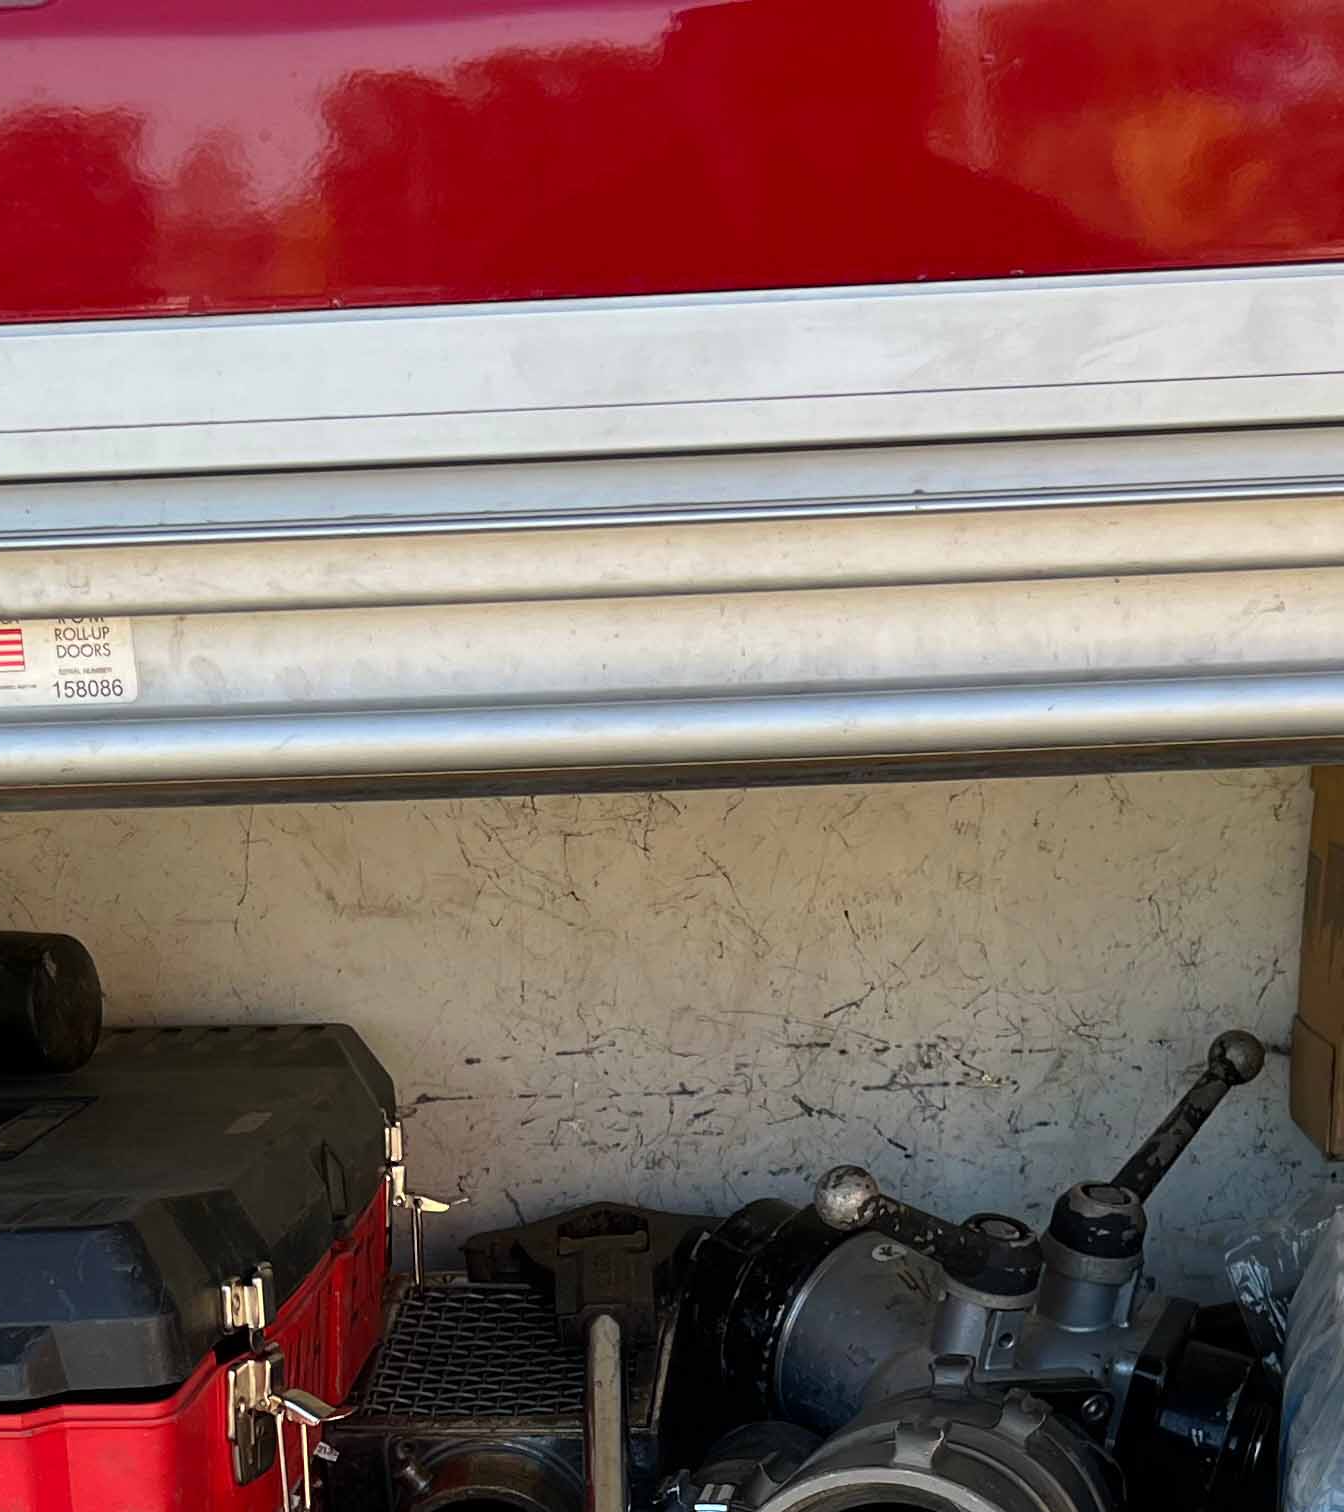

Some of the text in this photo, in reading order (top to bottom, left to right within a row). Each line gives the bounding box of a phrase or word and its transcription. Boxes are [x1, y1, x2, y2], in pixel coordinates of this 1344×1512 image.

[54, 626, 110, 641] ROLL-UP
[56, 643, 111, 658] DOORS
[52, 679, 124, 699] 158086
